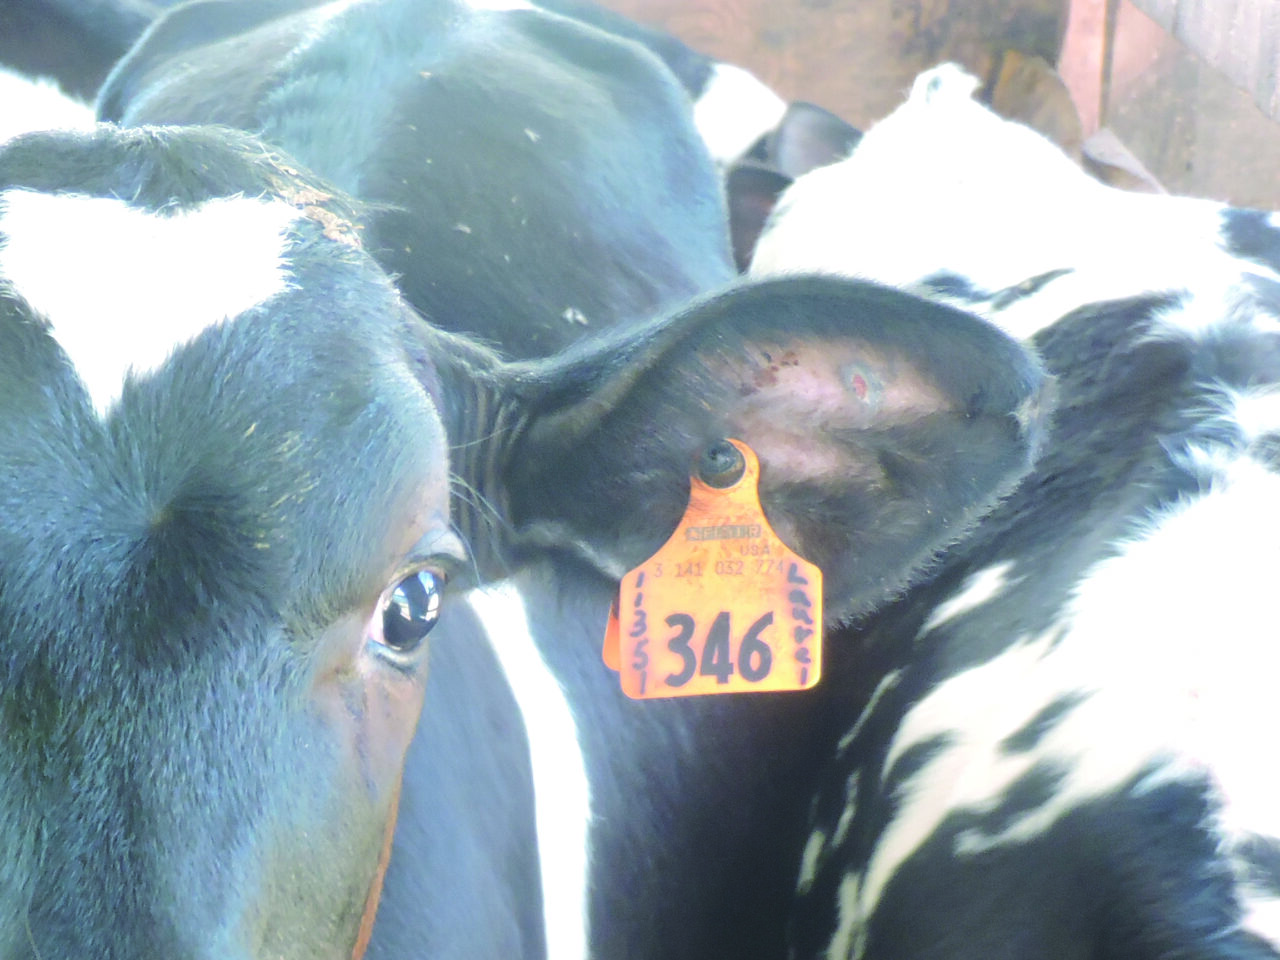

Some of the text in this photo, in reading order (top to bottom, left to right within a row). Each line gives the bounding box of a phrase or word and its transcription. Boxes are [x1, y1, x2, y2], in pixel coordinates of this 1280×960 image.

[674, 562, 703, 577] 141
[714, 560, 744, 575] 032
[664, 611, 774, 688] 346
